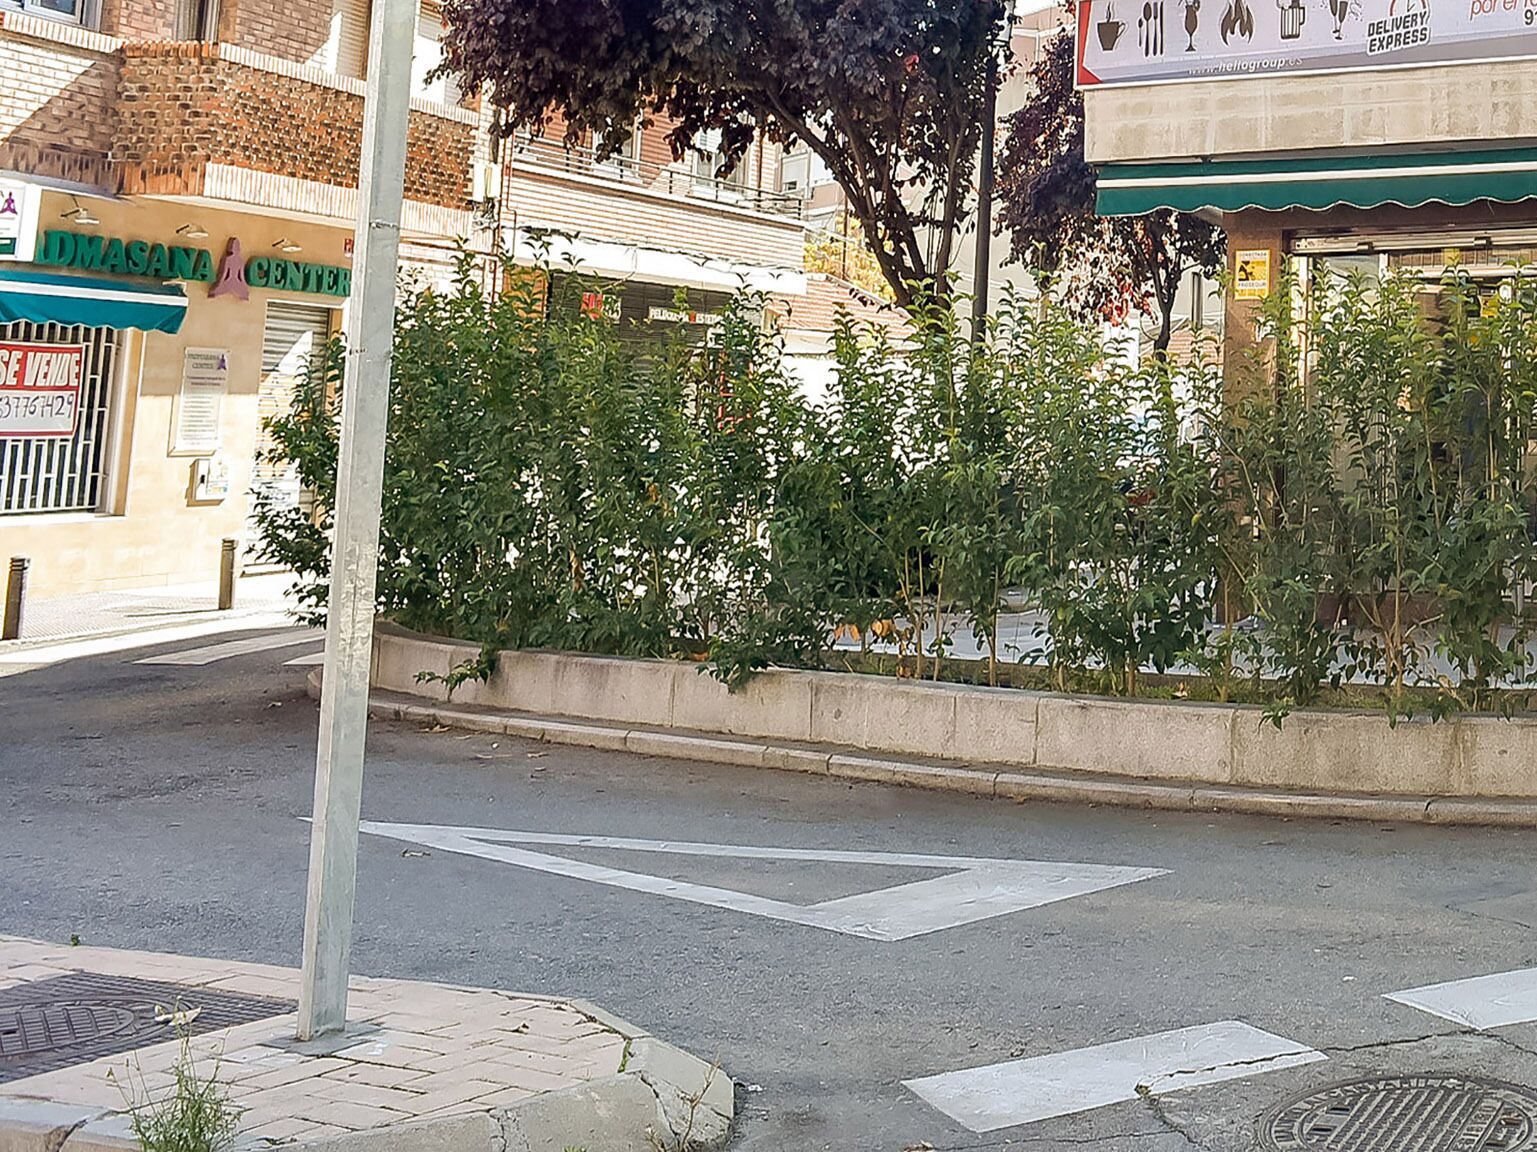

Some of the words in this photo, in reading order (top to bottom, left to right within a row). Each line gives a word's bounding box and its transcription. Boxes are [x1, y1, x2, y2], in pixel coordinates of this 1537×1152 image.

[1367, 11, 1428, 37] DELIVERY
[1368, 27, 1428, 53] EXPRESS
[246, 257, 351, 297] CENTER
[23, 352, 81, 387] VENDE
[0, 393, 75, 419] 37767429
